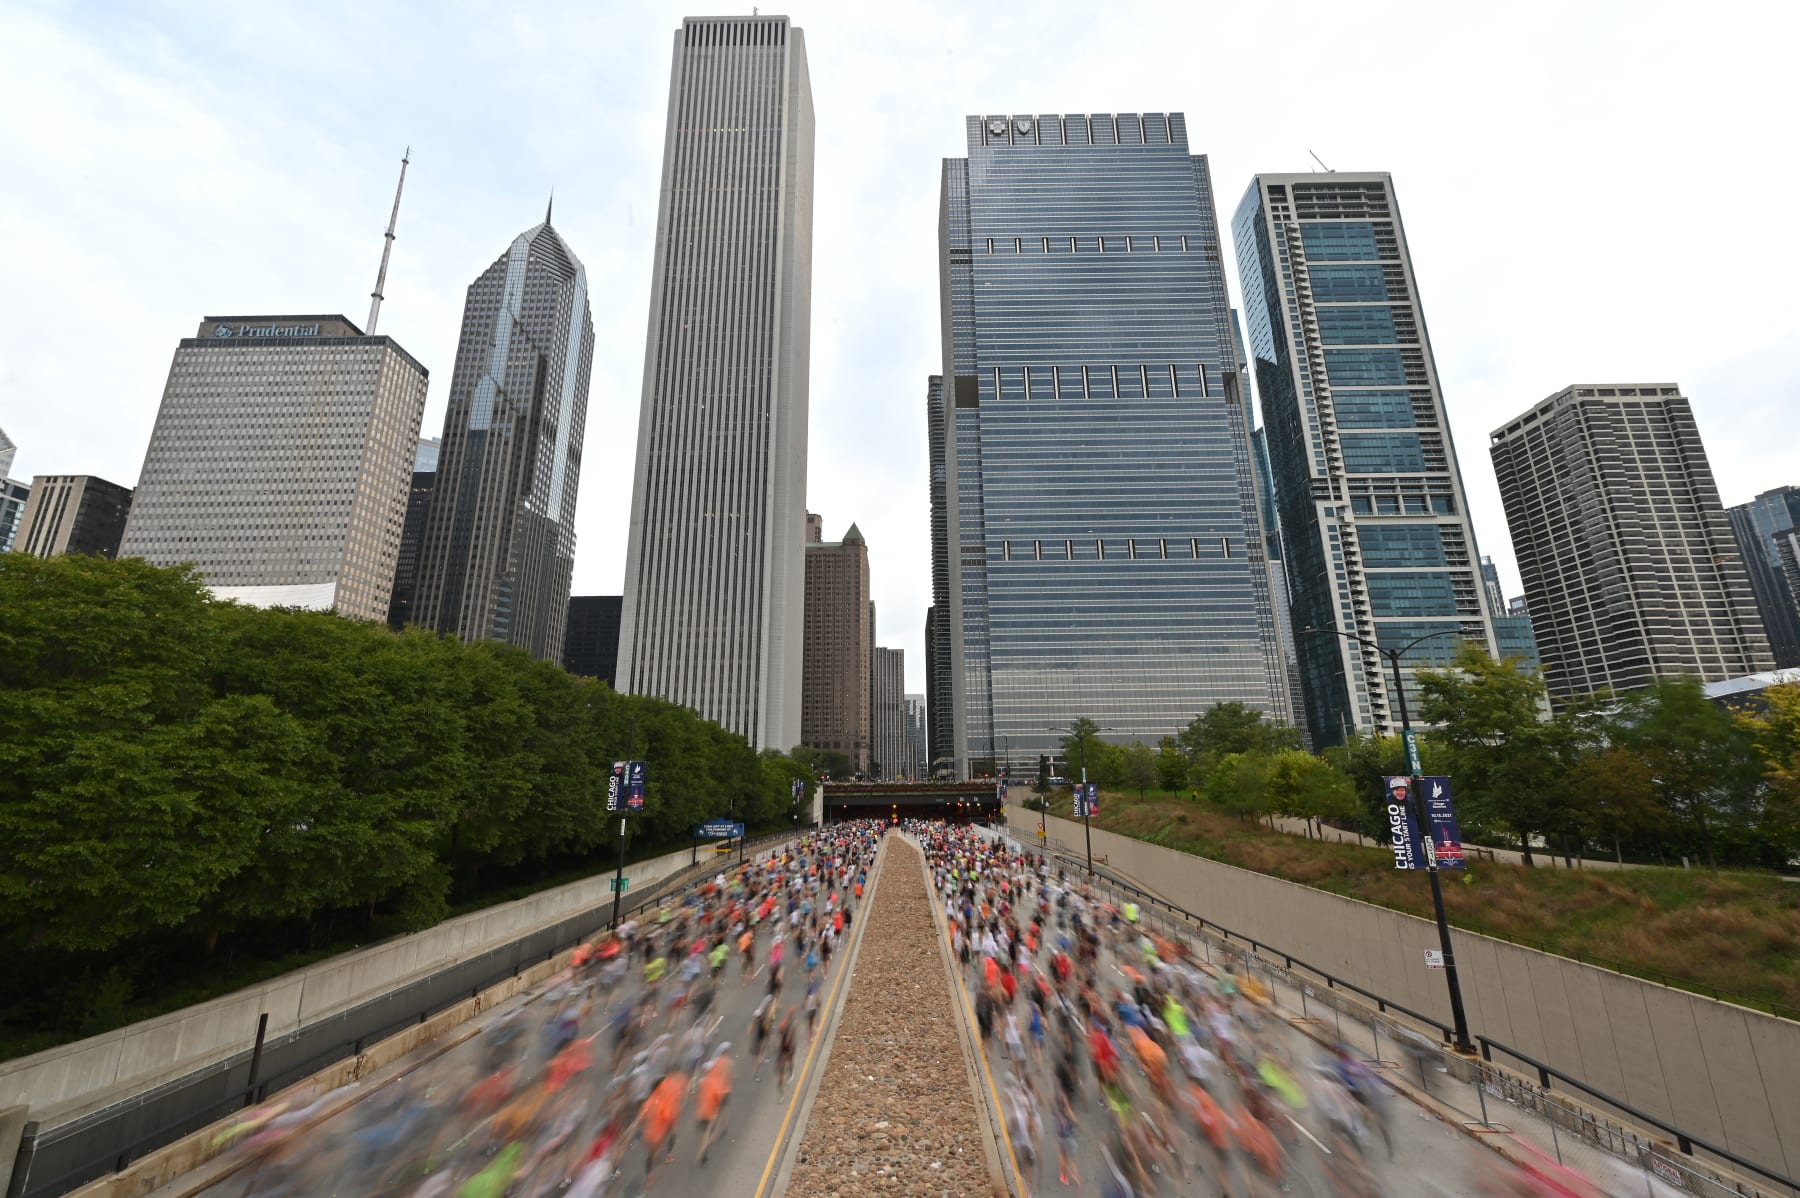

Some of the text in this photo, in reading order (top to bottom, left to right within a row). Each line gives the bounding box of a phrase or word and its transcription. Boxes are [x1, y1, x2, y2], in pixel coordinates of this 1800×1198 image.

[238, 323, 320, 337] Prudential
[1407, 734, 1421, 770] C31N
[606, 776, 616, 811] CHICAGO
[1387, 804, 1408, 869] CHICAGO
[1402, 821, 1410, 842] START
[1405, 843, 1413, 861] YOUR
